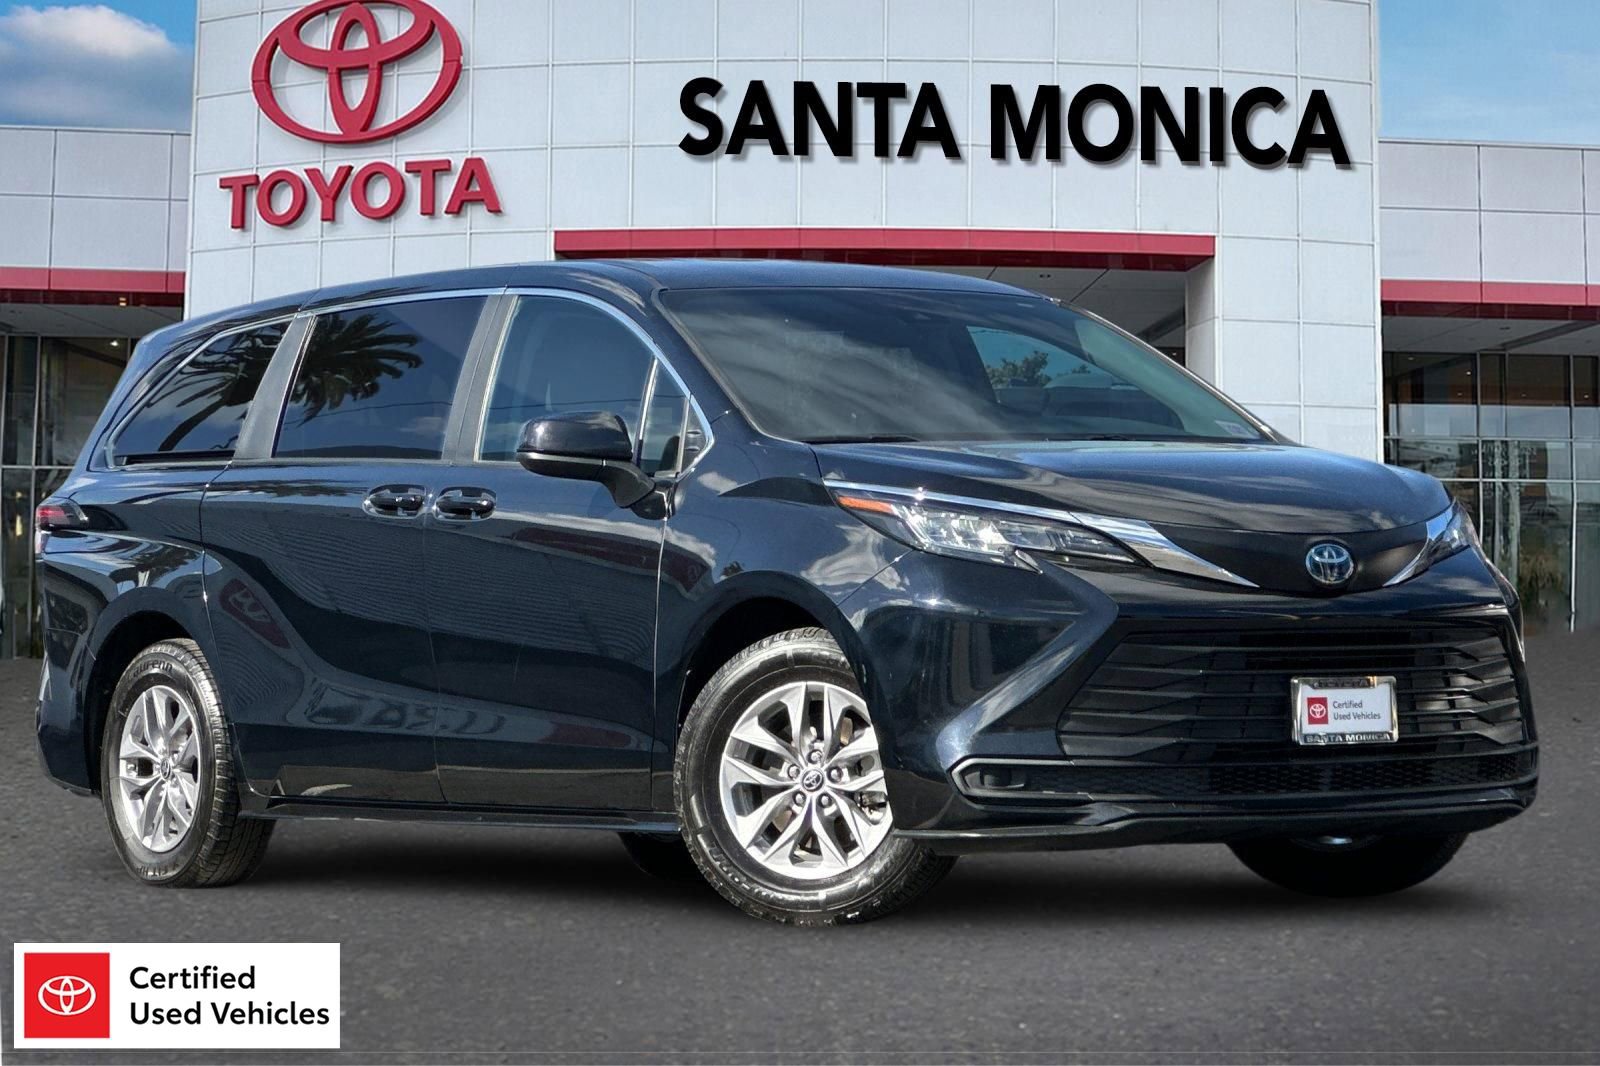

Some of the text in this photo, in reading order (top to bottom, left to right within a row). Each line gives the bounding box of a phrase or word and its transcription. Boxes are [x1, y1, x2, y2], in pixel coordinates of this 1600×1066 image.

[679, 78, 1351, 166] SANTA MONICA
[220, 157, 502, 230] TOYOTA
[1333, 700, 1363, 709] Certified
[1333, 711, 1381, 720] Used Vehicles
